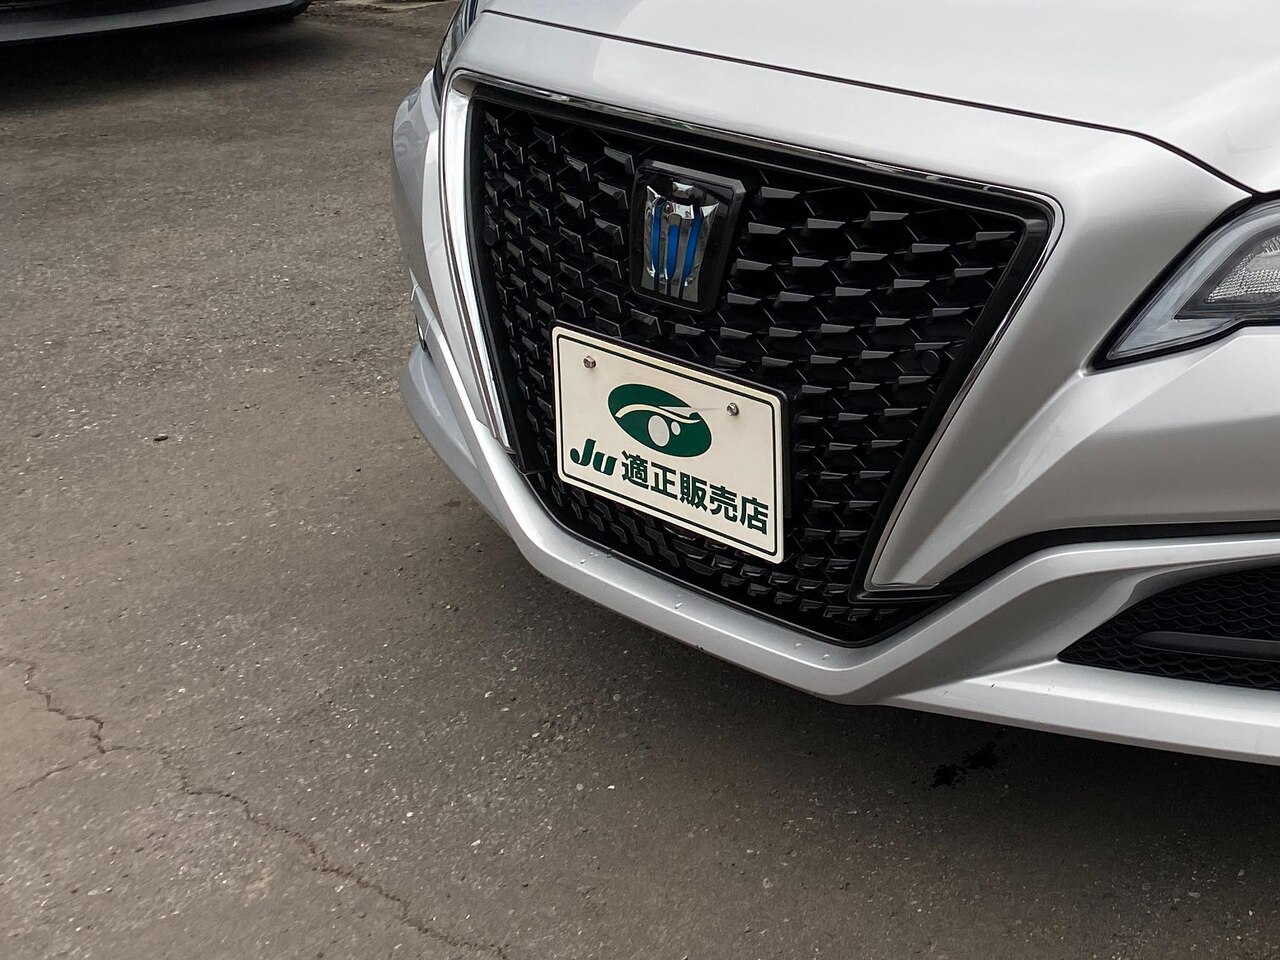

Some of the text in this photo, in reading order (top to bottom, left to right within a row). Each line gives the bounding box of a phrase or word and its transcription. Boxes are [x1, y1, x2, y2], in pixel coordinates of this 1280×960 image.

[621, 450, 769, 536] 適正販売店
